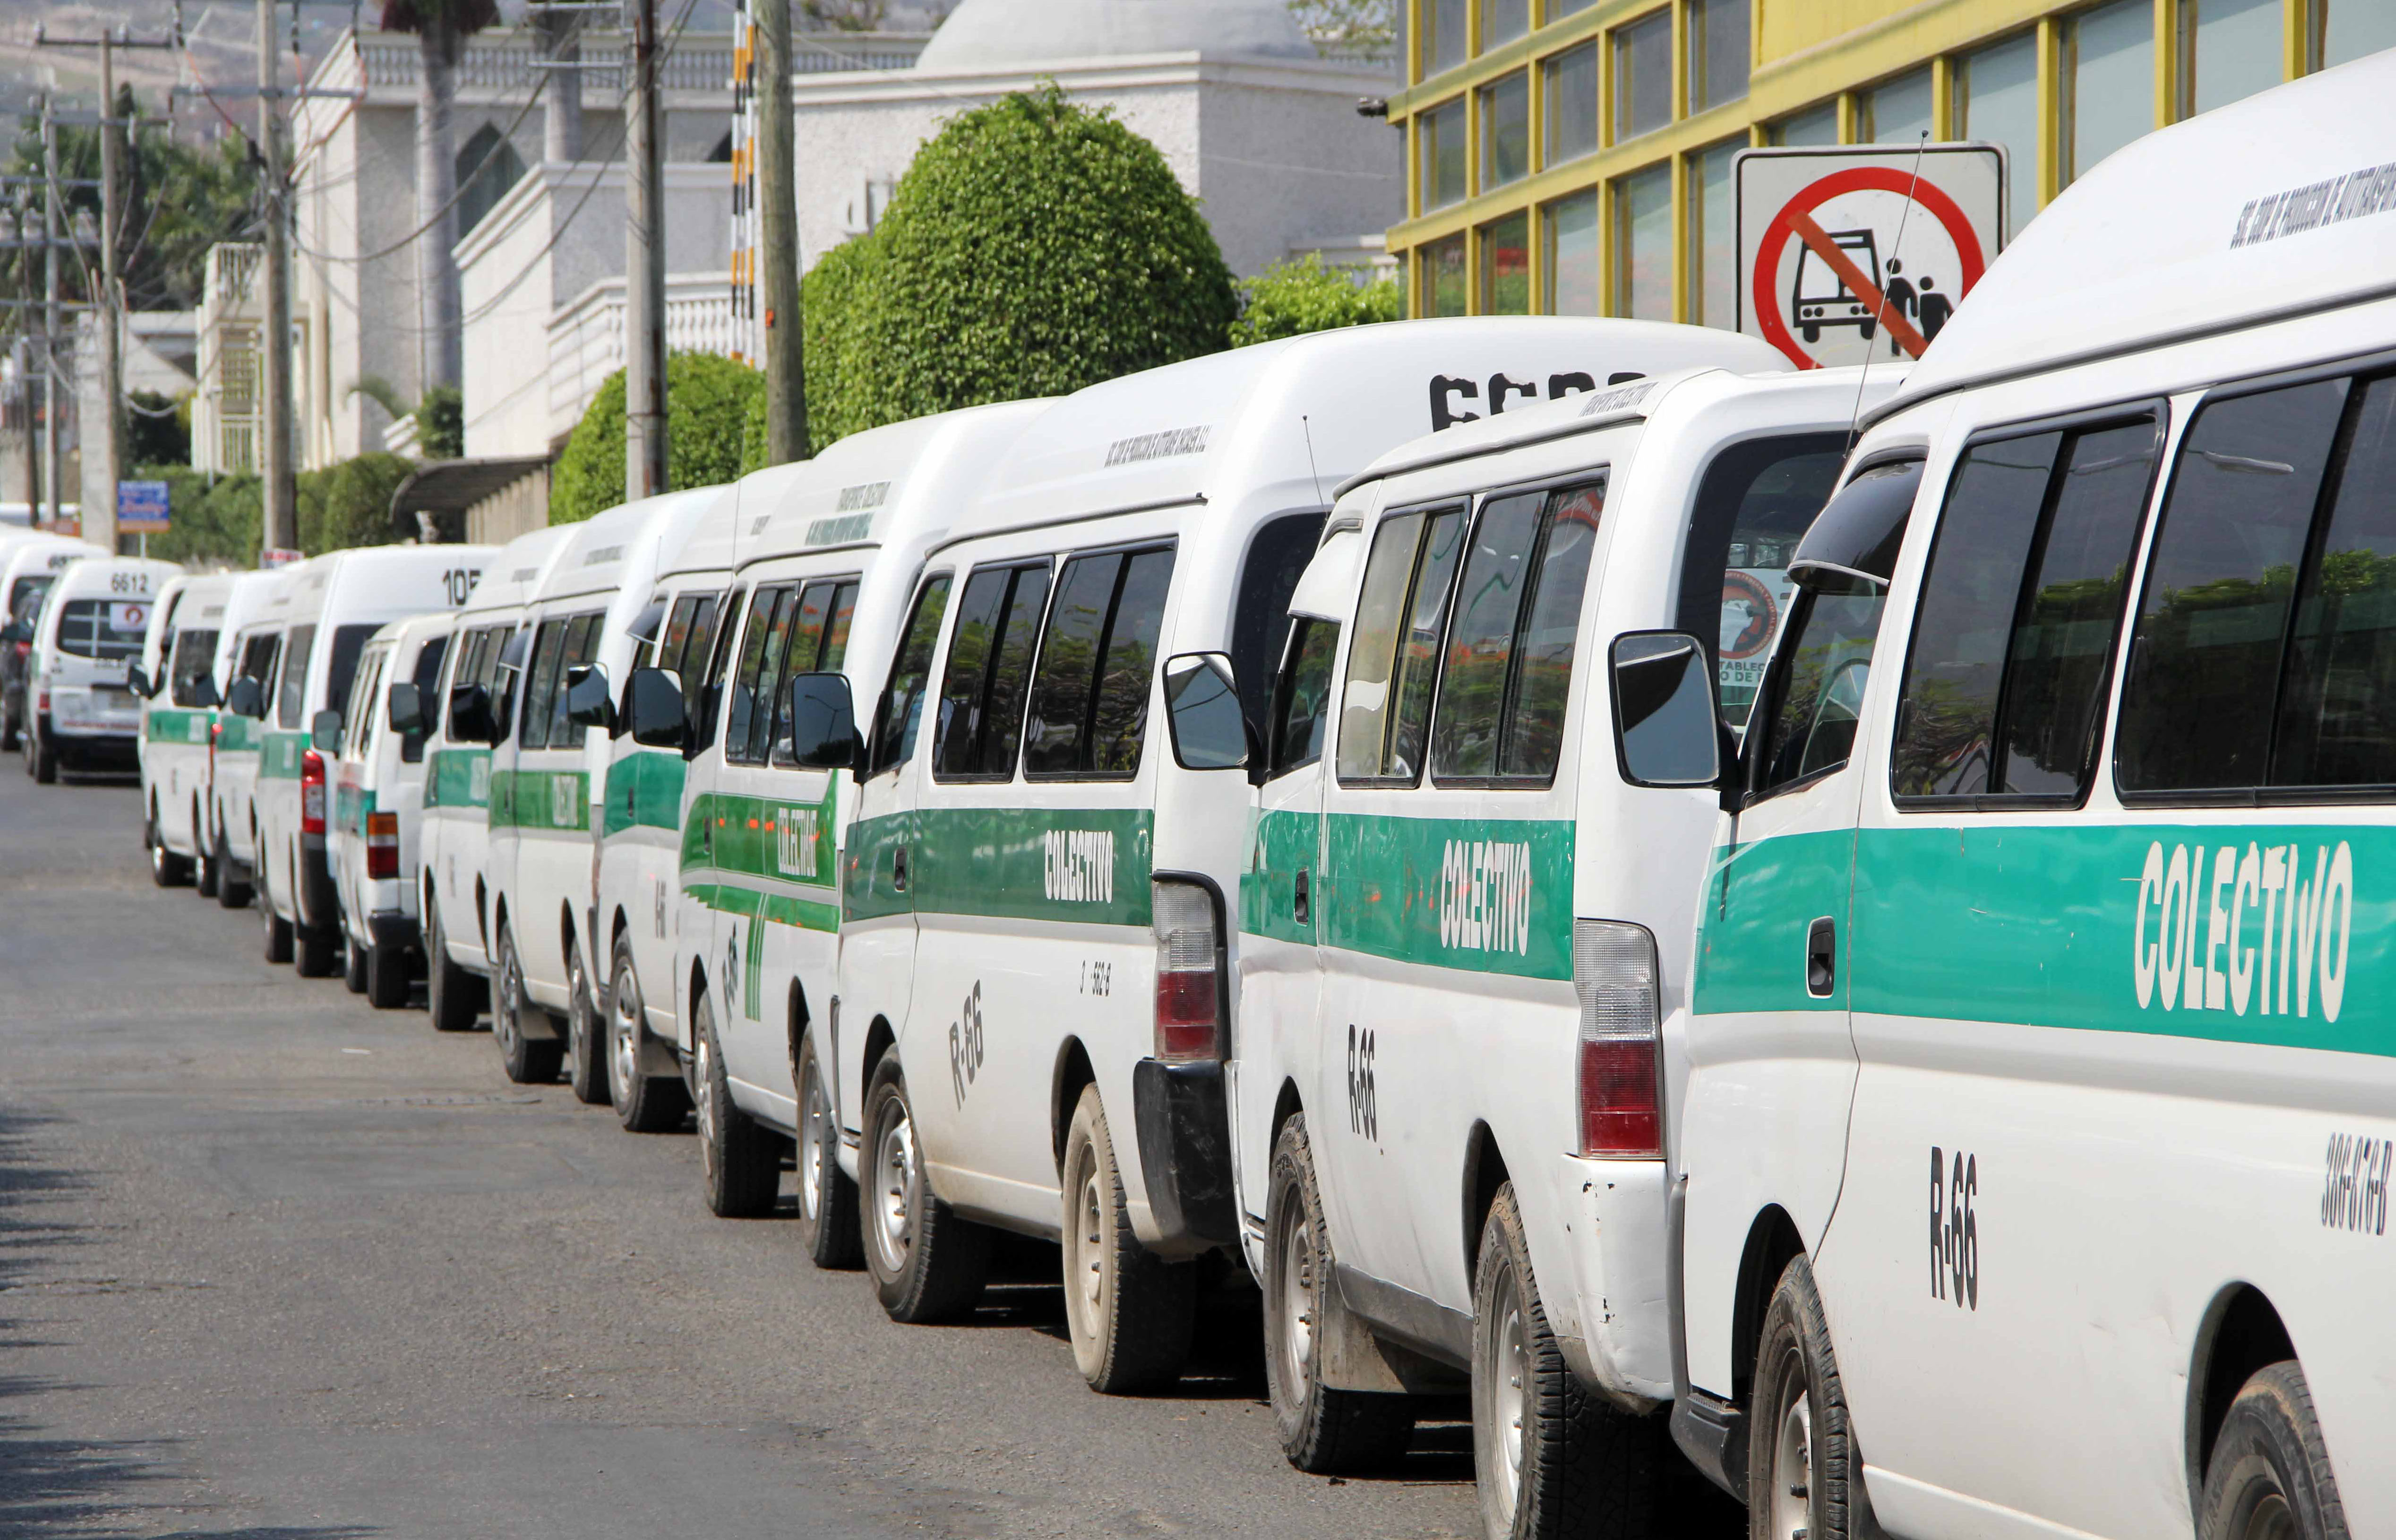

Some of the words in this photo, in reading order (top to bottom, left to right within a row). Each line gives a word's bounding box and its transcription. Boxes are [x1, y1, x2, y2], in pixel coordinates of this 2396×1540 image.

[111, 573, 148, 592] 6612
[1735, 671, 1752, 682] DE
[1044, 829, 1113, 903] COLECTIVO
[1440, 838, 1530, 957] COLECTIVO
[2134, 840, 2353, 1023] COLECTIVO
[949, 978, 984, 1112] R-66
[1348, 1024, 1377, 1143] R-66
[1931, 1146, 1977, 1311] R-66
